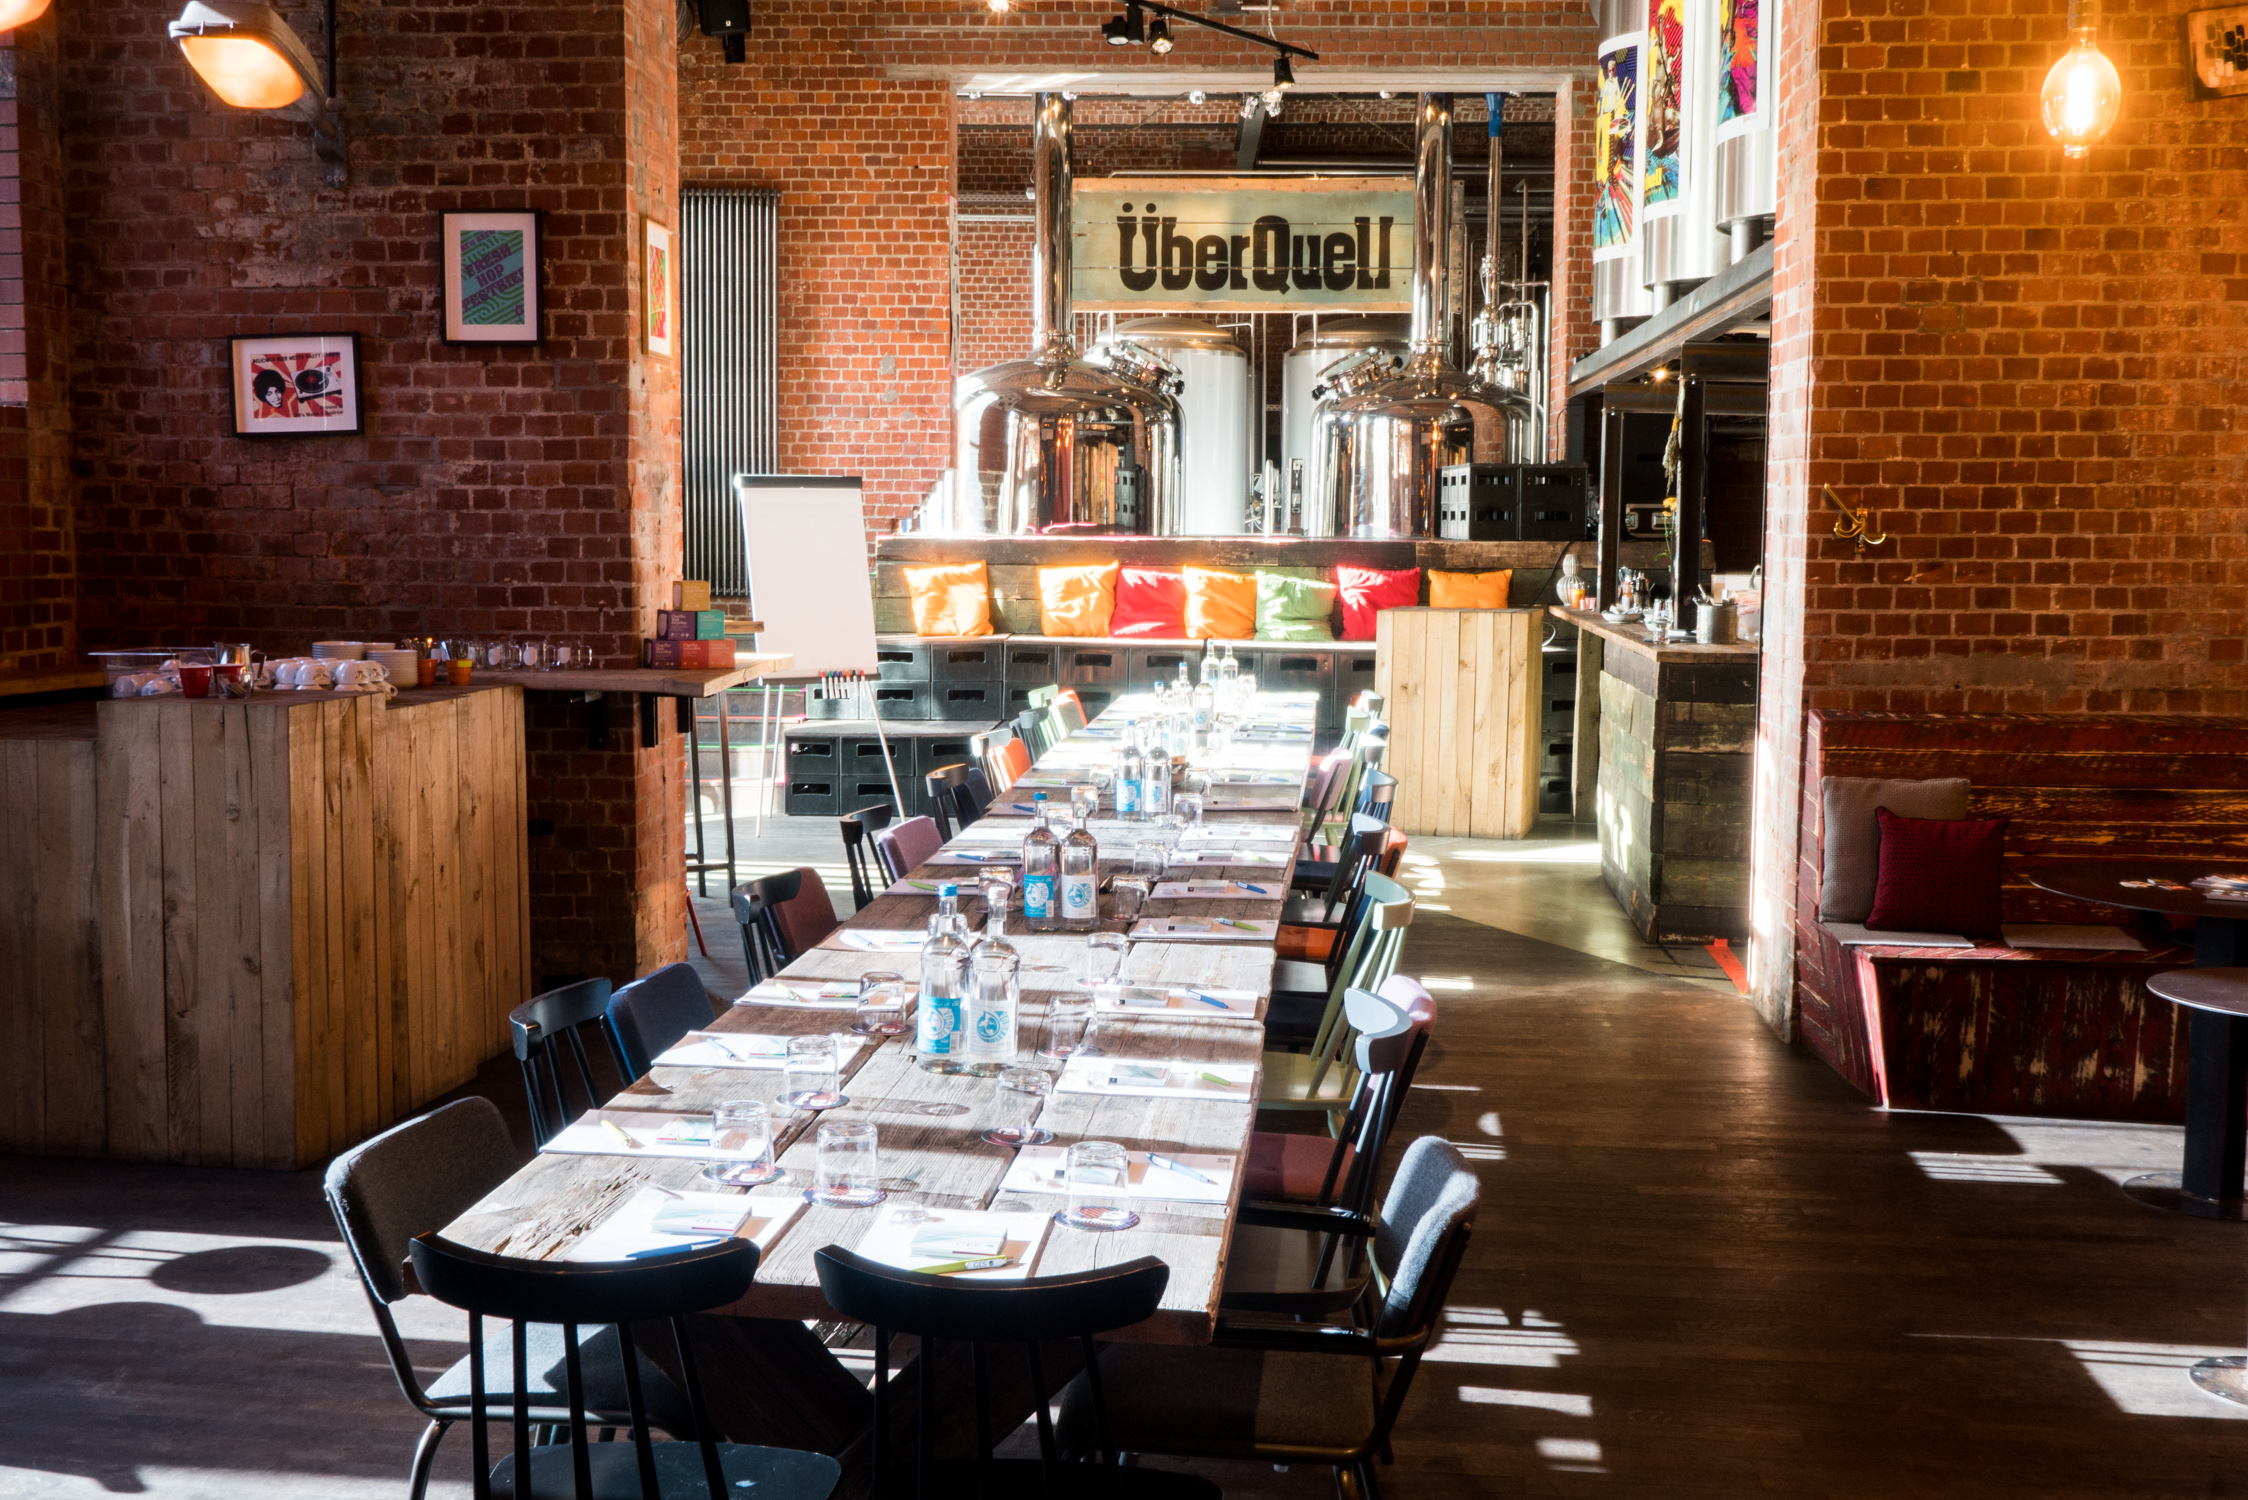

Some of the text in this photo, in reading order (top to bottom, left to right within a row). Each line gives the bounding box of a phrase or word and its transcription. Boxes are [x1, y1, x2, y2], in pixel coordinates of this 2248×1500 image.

[461, 239, 476, 252] NEW
[464, 243, 512, 278] FRESH
[1116, 202, 1394, 294] ÜberQuell
[476, 263, 505, 288] HOP
